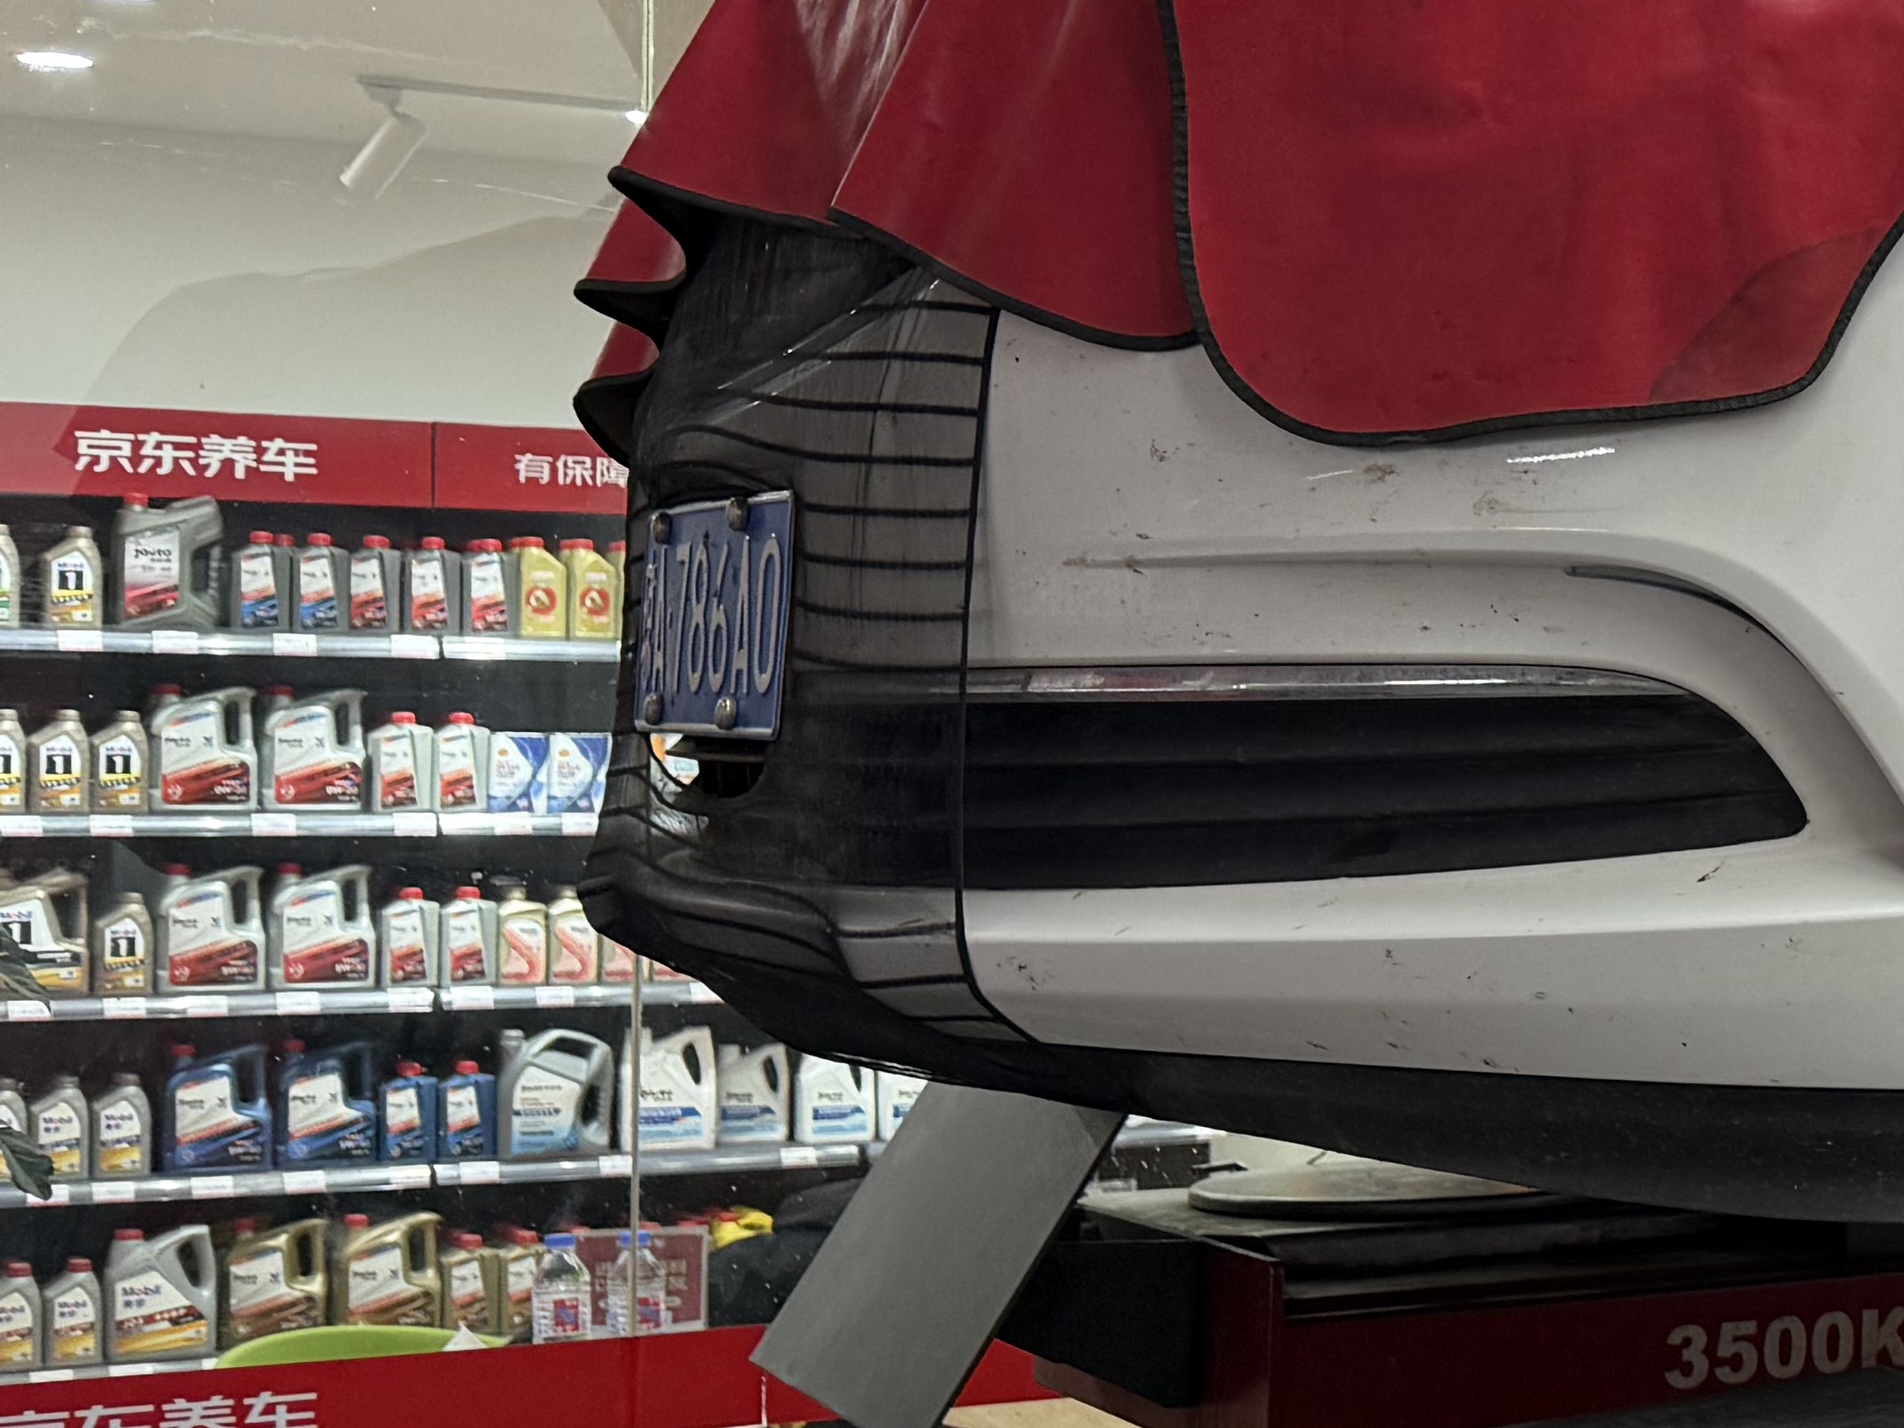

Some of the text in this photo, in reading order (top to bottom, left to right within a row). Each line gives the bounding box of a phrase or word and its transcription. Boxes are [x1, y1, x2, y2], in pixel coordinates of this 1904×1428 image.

[74, 429, 318, 482] 京东养车
[121, 1283, 162, 1297] Mobil
